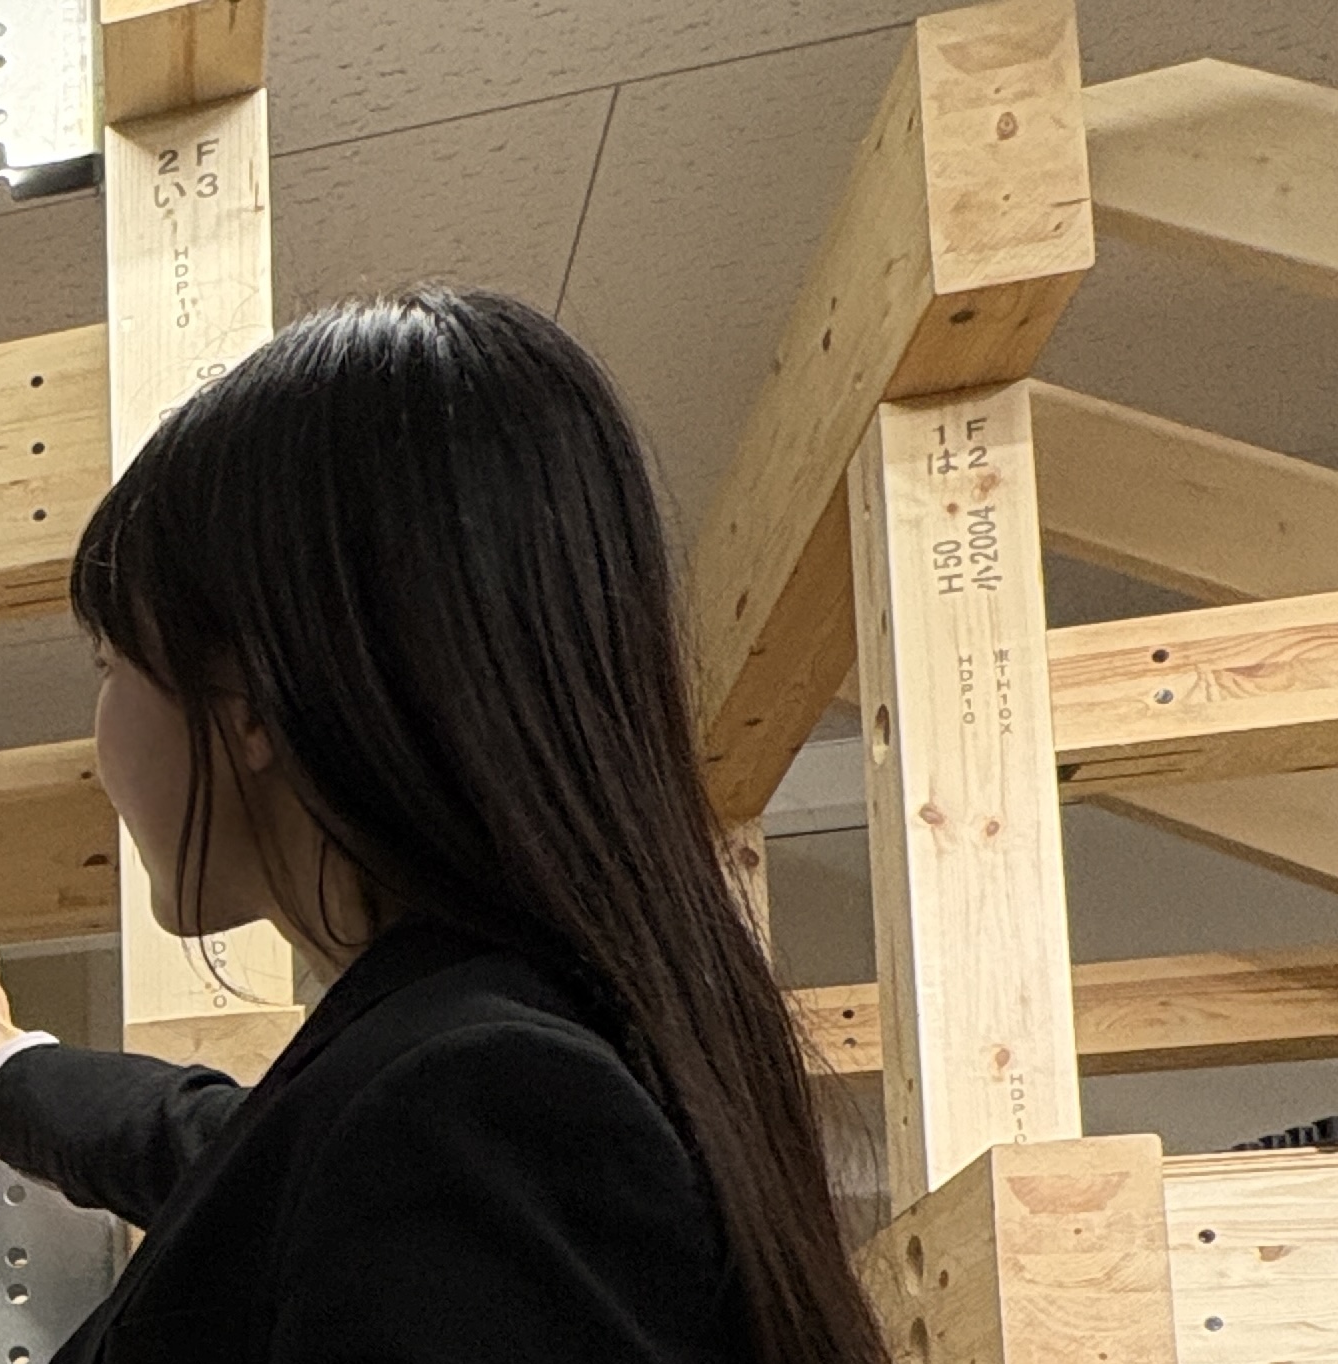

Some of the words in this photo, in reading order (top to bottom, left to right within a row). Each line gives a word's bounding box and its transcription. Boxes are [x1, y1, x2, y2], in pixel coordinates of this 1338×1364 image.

[174, 246, 190, 328] HDP10
[966, 504, 1003, 591] 小2004
[958, 654, 975, 724] HDP10
